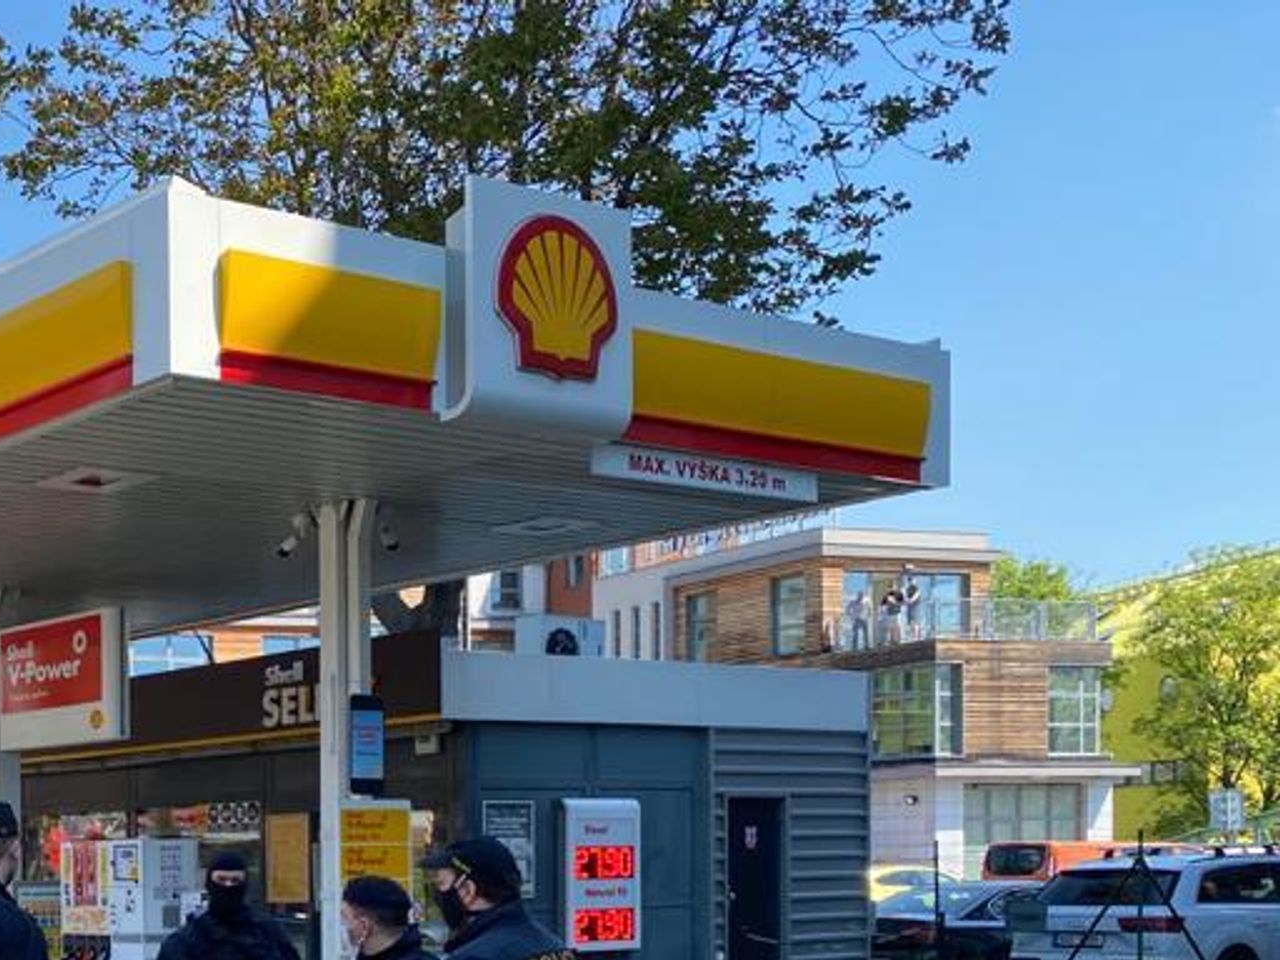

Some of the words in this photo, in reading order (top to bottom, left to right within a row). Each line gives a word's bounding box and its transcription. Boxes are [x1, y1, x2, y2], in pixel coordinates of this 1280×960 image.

[628, 453, 671, 475] MAX.
[772, 477, 787, 491] m
[6, 659, 82, 687] V-Power
[264, 660, 304, 686] Shell
